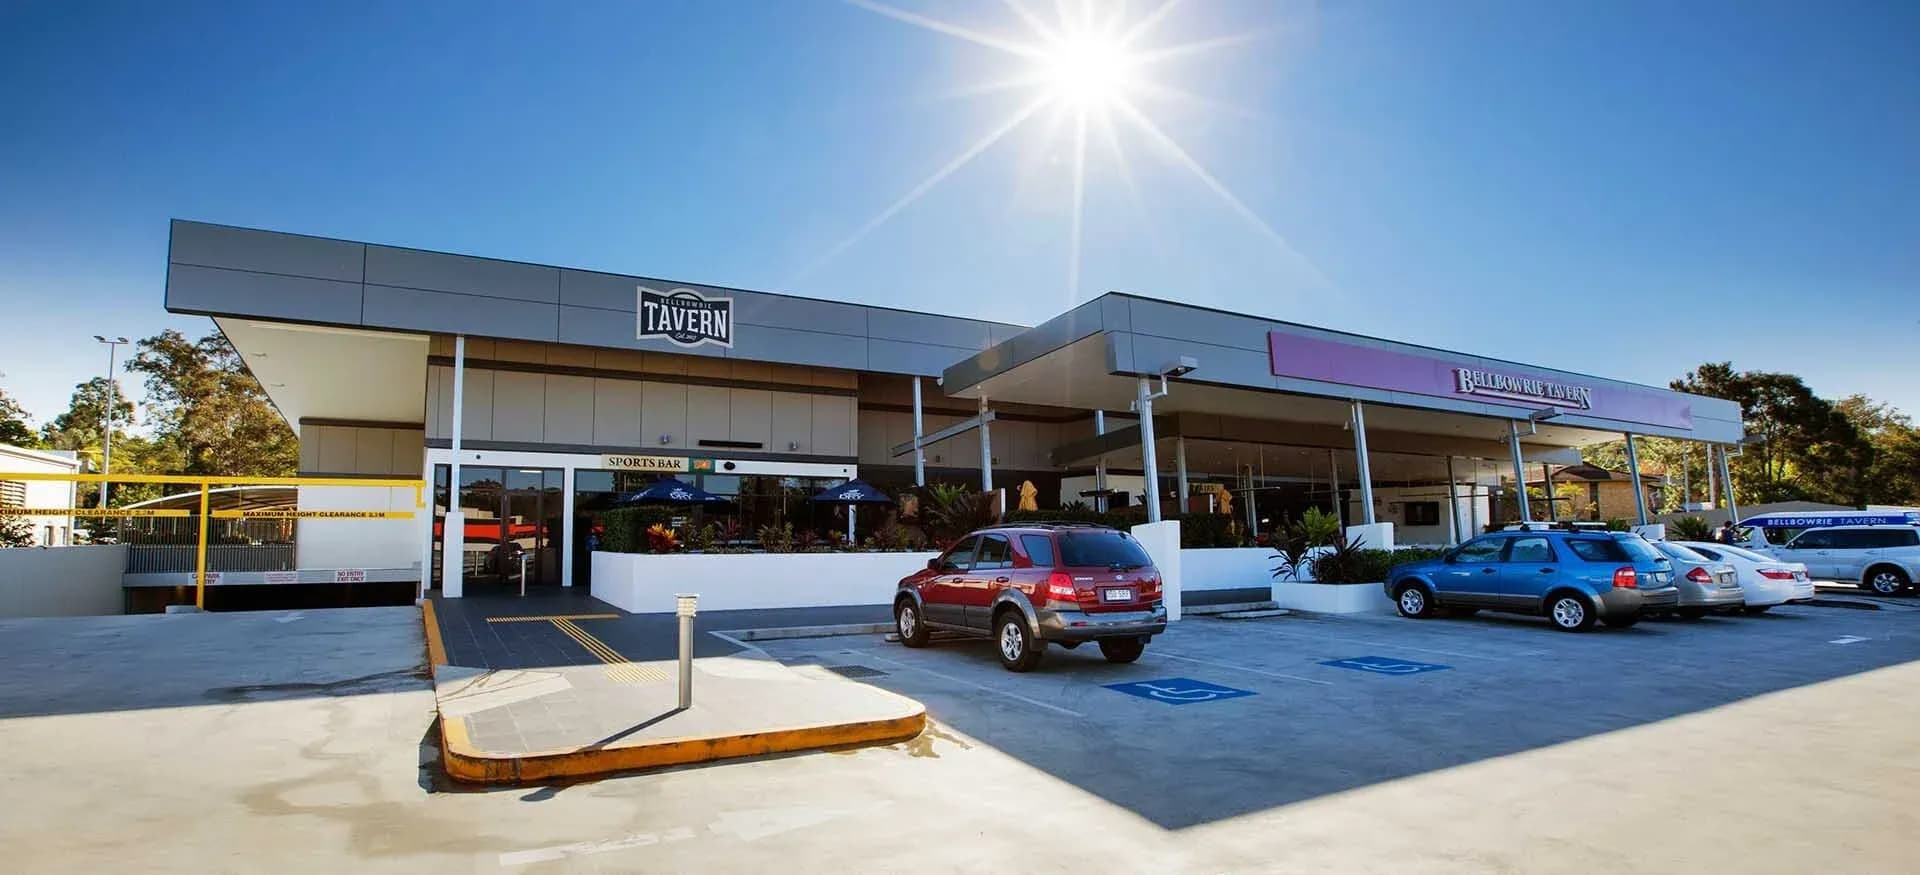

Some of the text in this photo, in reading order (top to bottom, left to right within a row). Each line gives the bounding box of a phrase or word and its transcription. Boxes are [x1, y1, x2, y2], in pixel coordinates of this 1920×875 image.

[660, 298, 712, 309] BELLBOWRIE
[644, 301, 727, 338] TAVERN
[1457, 368, 1592, 410] BELLBOWRIE TAVERN
[608, 457, 656, 468] SPORTS
[658, 459, 681, 469] BAR
[1767, 517, 1887, 526] BELLBOWRIE TAVERN
